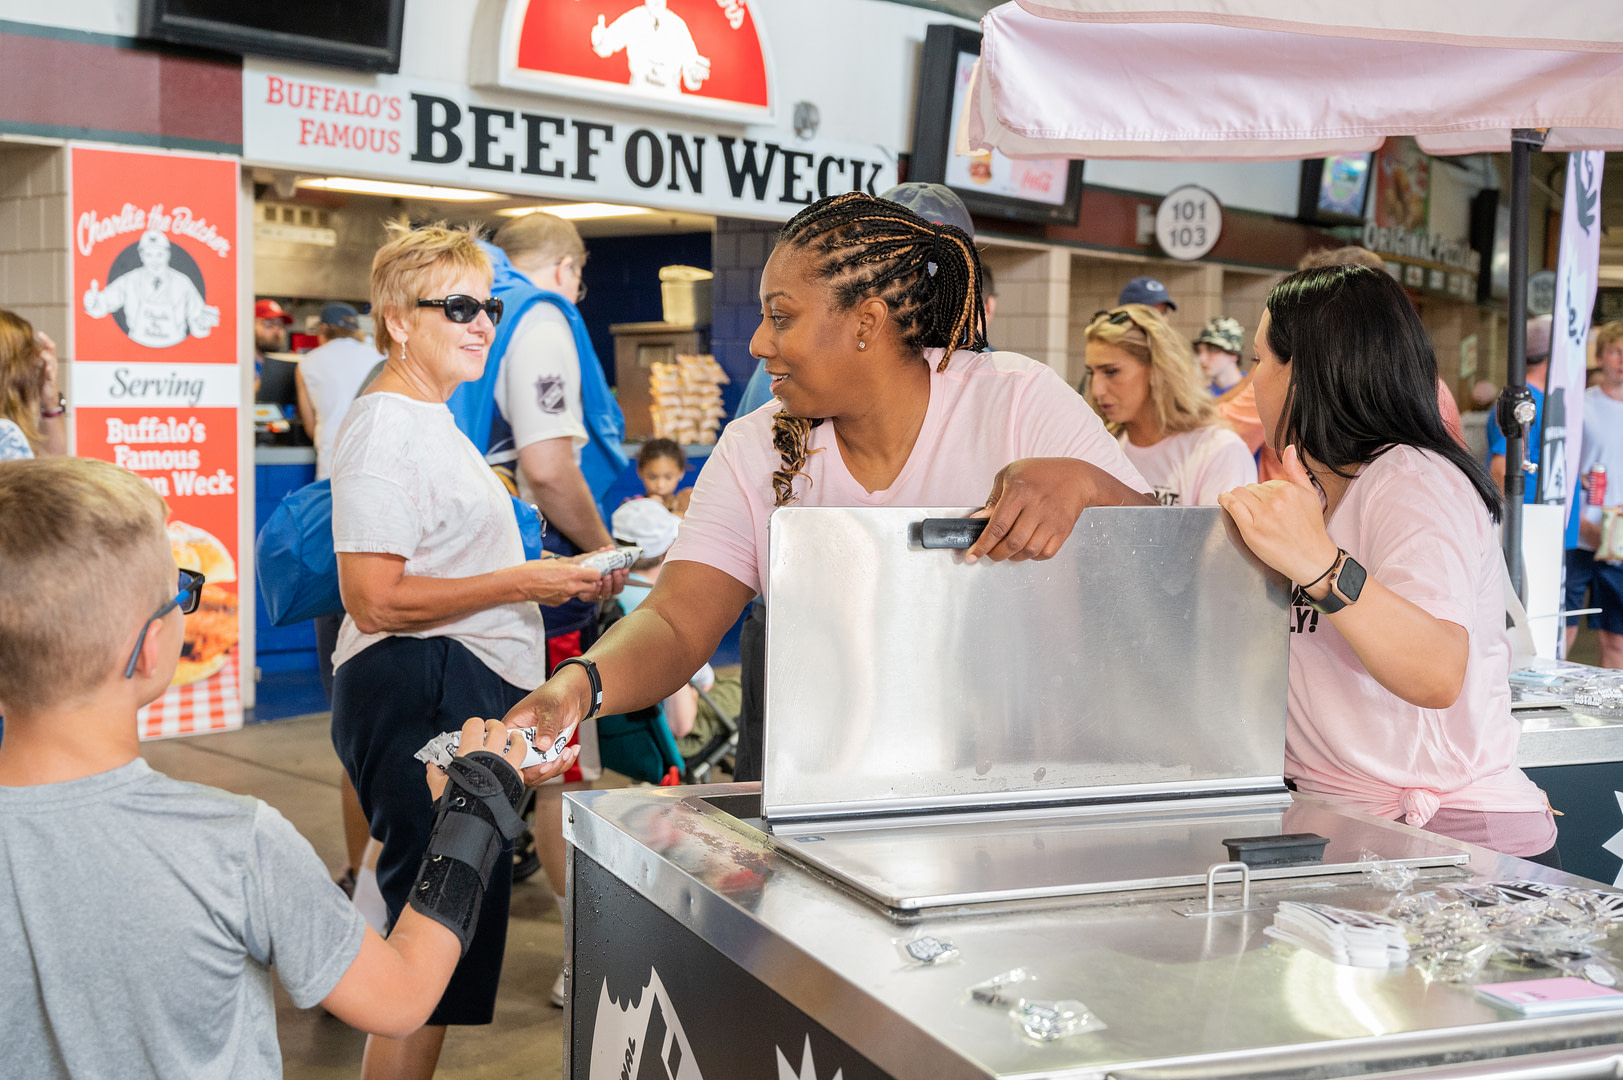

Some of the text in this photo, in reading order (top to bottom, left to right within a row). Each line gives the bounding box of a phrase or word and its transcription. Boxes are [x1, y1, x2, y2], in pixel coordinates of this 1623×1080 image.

[266, 75, 402, 121] BUFFALO'S
[298, 118, 401, 154] FAMOUS
[410, 93, 883, 205] BEEF ON WECK
[1172, 200, 1206, 222] 101
[77, 203, 146, 257] Charlie
[147, 203, 172, 232] the
[1170, 226, 1206, 248] 103
[109, 367, 205, 405] Serving
[105, 416, 206, 444] Buffalo's
[113, 445, 201, 471] Famous
[171, 468, 235, 497] Weck
